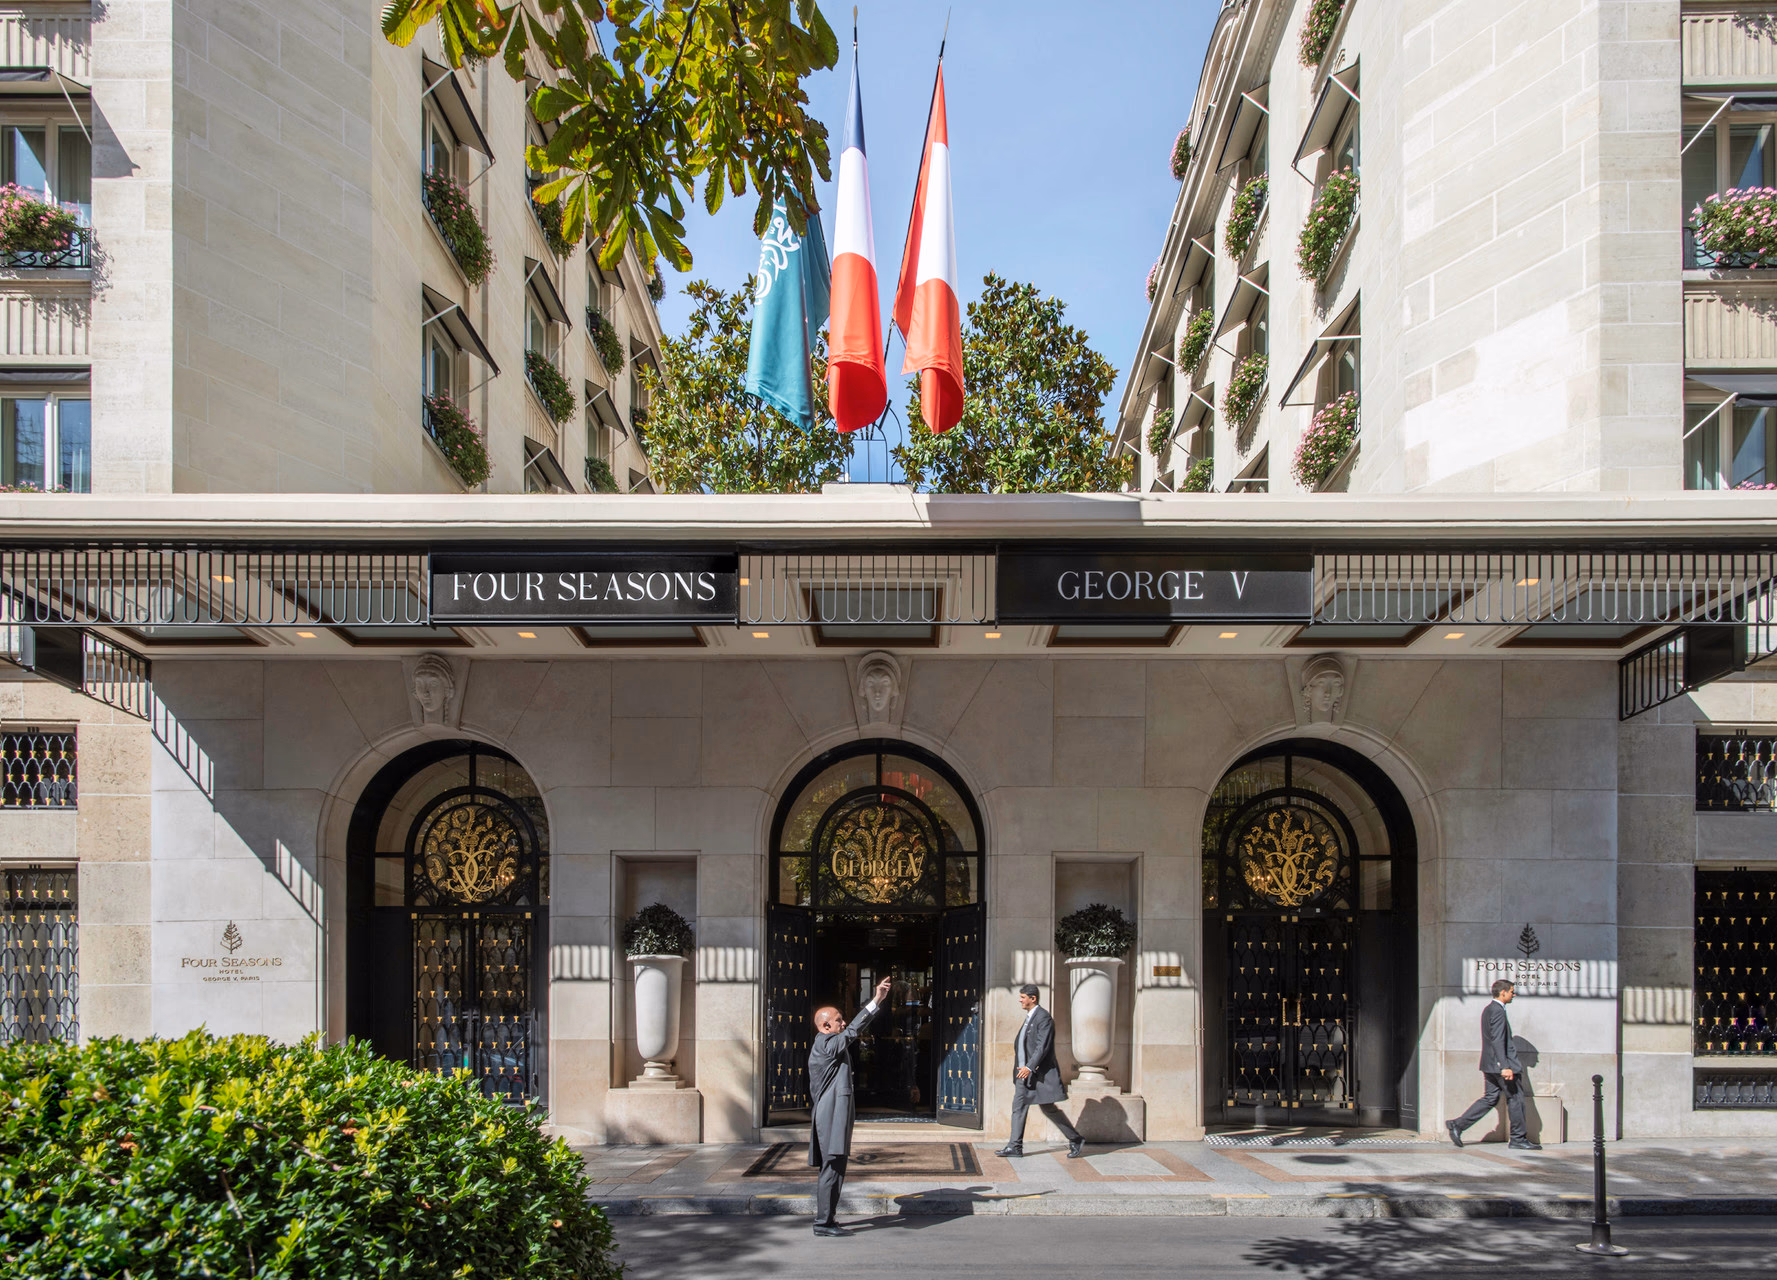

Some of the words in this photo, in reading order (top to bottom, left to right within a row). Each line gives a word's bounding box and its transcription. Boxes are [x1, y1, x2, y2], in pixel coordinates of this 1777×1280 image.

[451, 571, 545, 601] FOUR
[558, 571, 716, 601] SEASONS
[1057, 570, 1204, 600] GEORGE
[1230, 571, 1250, 600] V
[181, 957, 218, 968] FOUR
[221, 957, 282, 968] SEASONS
[1476, 961, 1514, 972] FOUR
[1518, 961, 1581, 972] SEASONS
